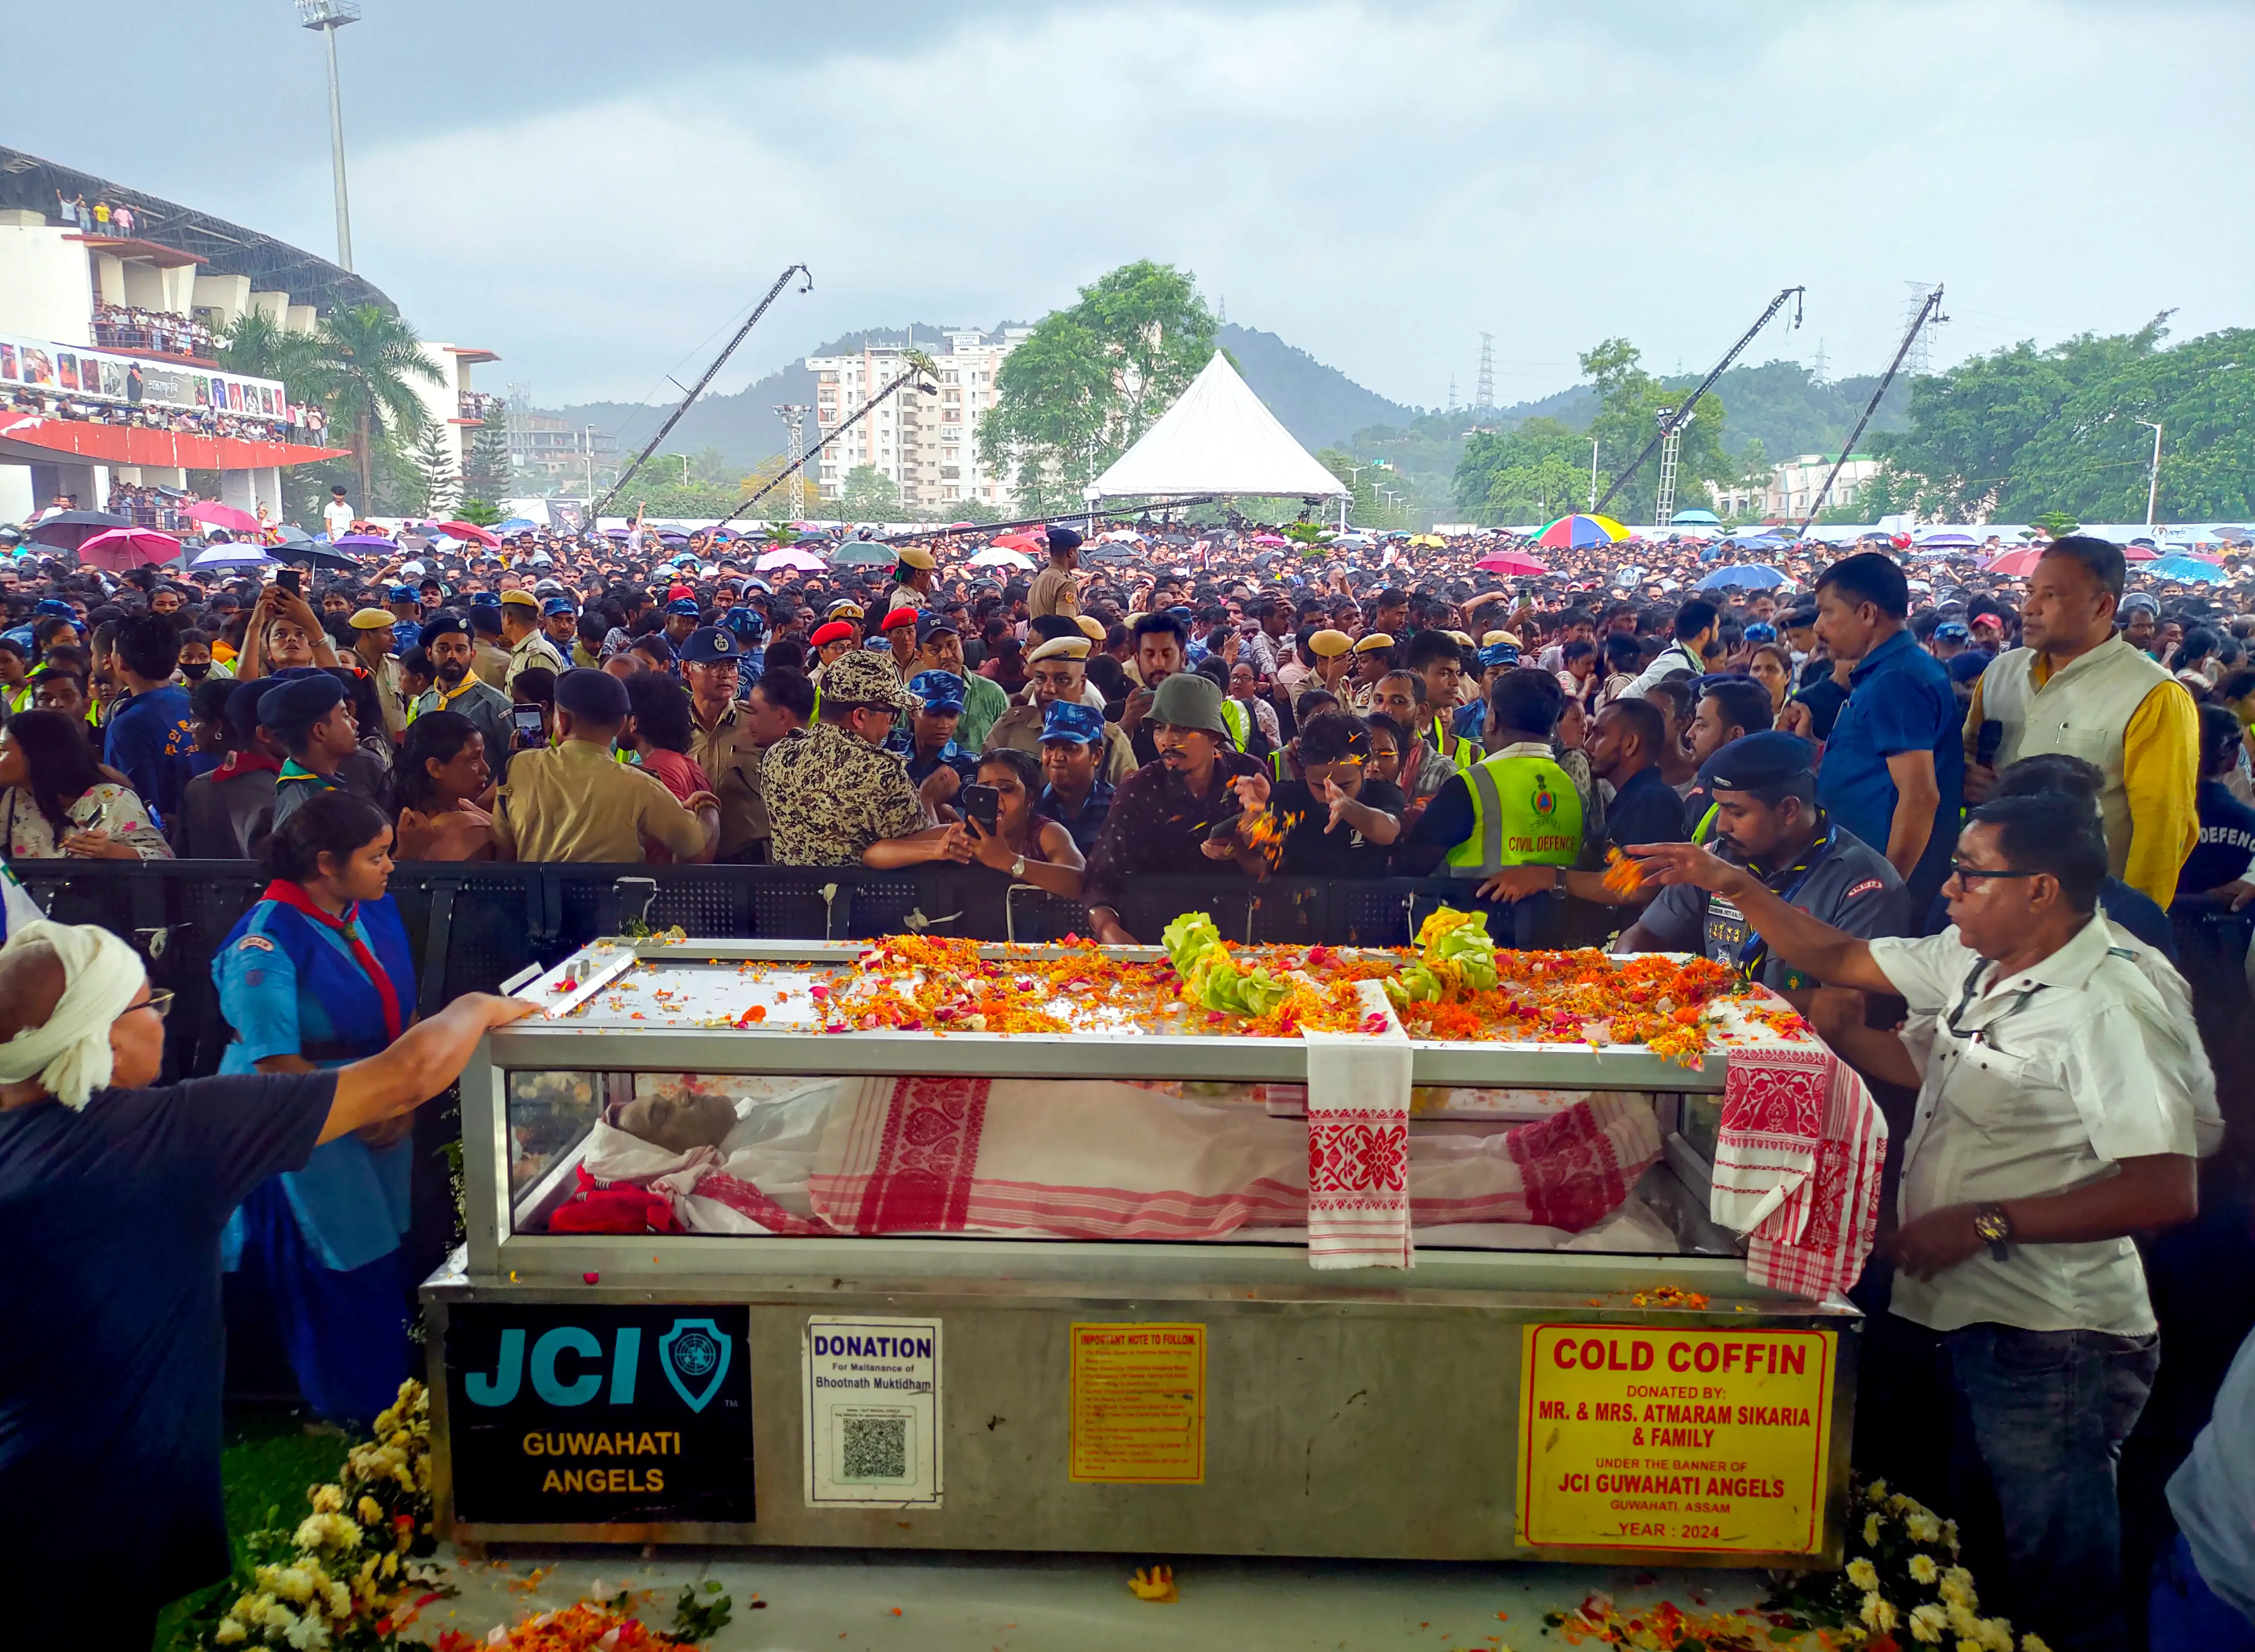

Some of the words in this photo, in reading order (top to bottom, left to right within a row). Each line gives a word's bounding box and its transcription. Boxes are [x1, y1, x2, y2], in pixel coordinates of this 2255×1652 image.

[1509, 837, 1534, 852] CIVIL
[1537, 835, 1575, 852] DEFENCE
[1851, 880, 1879, 893] INDIA
[815, 1336, 931, 1358] DONATION
[1081, 1335, 1125, 1345] IMPORTANT
[1128, 1334, 1148, 1345] NOTE
[1151, 1334, 1161, 1345] TO
[1163, 1335, 1196, 1345] FOLLOW.
[1553, 1338, 1654, 1371] COLD
[1668, 1341, 1806, 1375] COFFIN
[465, 1327, 641, 1407] JCI
[851, 1363, 902, 1372] Maitanance
[816, 1377, 870, 1388] Bhootnath
[874, 1377, 931, 1389] Muktidham
[1627, 1385, 1698, 1399] DONATED
[1703, 1387, 1726, 1399] BY:
[1539, 1401, 1569, 1420] MR.
[1576, 1402, 1588, 1421] &
[1595, 1403, 1637, 1422] MRS.
[1643, 1404, 1731, 1424] ATMARAM
[1737, 1406, 1810, 1427] SIKARIA
[523, 1432, 680, 1456] GUWAHATI
[1633, 1428, 1644, 1446] &
[1651, 1428, 1714, 1448] FAMILY
[1596, 1458, 1639, 1469] UNDER
[1644, 1459, 1668, 1469] THE
[1673, 1460, 1726, 1471] BANNER
[1731, 1462, 1747, 1472] OF
[542, 1469, 664, 1493] ANGELS
[1558, 1473, 1589, 1493] JCI
[1596, 1474, 1700, 1496] GUWAHATI
[1706, 1478, 1784, 1498] ANGELS
[1610, 1500, 1681, 1513] GUWAHATI,
[1684, 1502, 1730, 1514] ASSAM
[1619, 1522, 1666, 1536] YEAR
[1682, 1525, 1719, 1539] 2024
